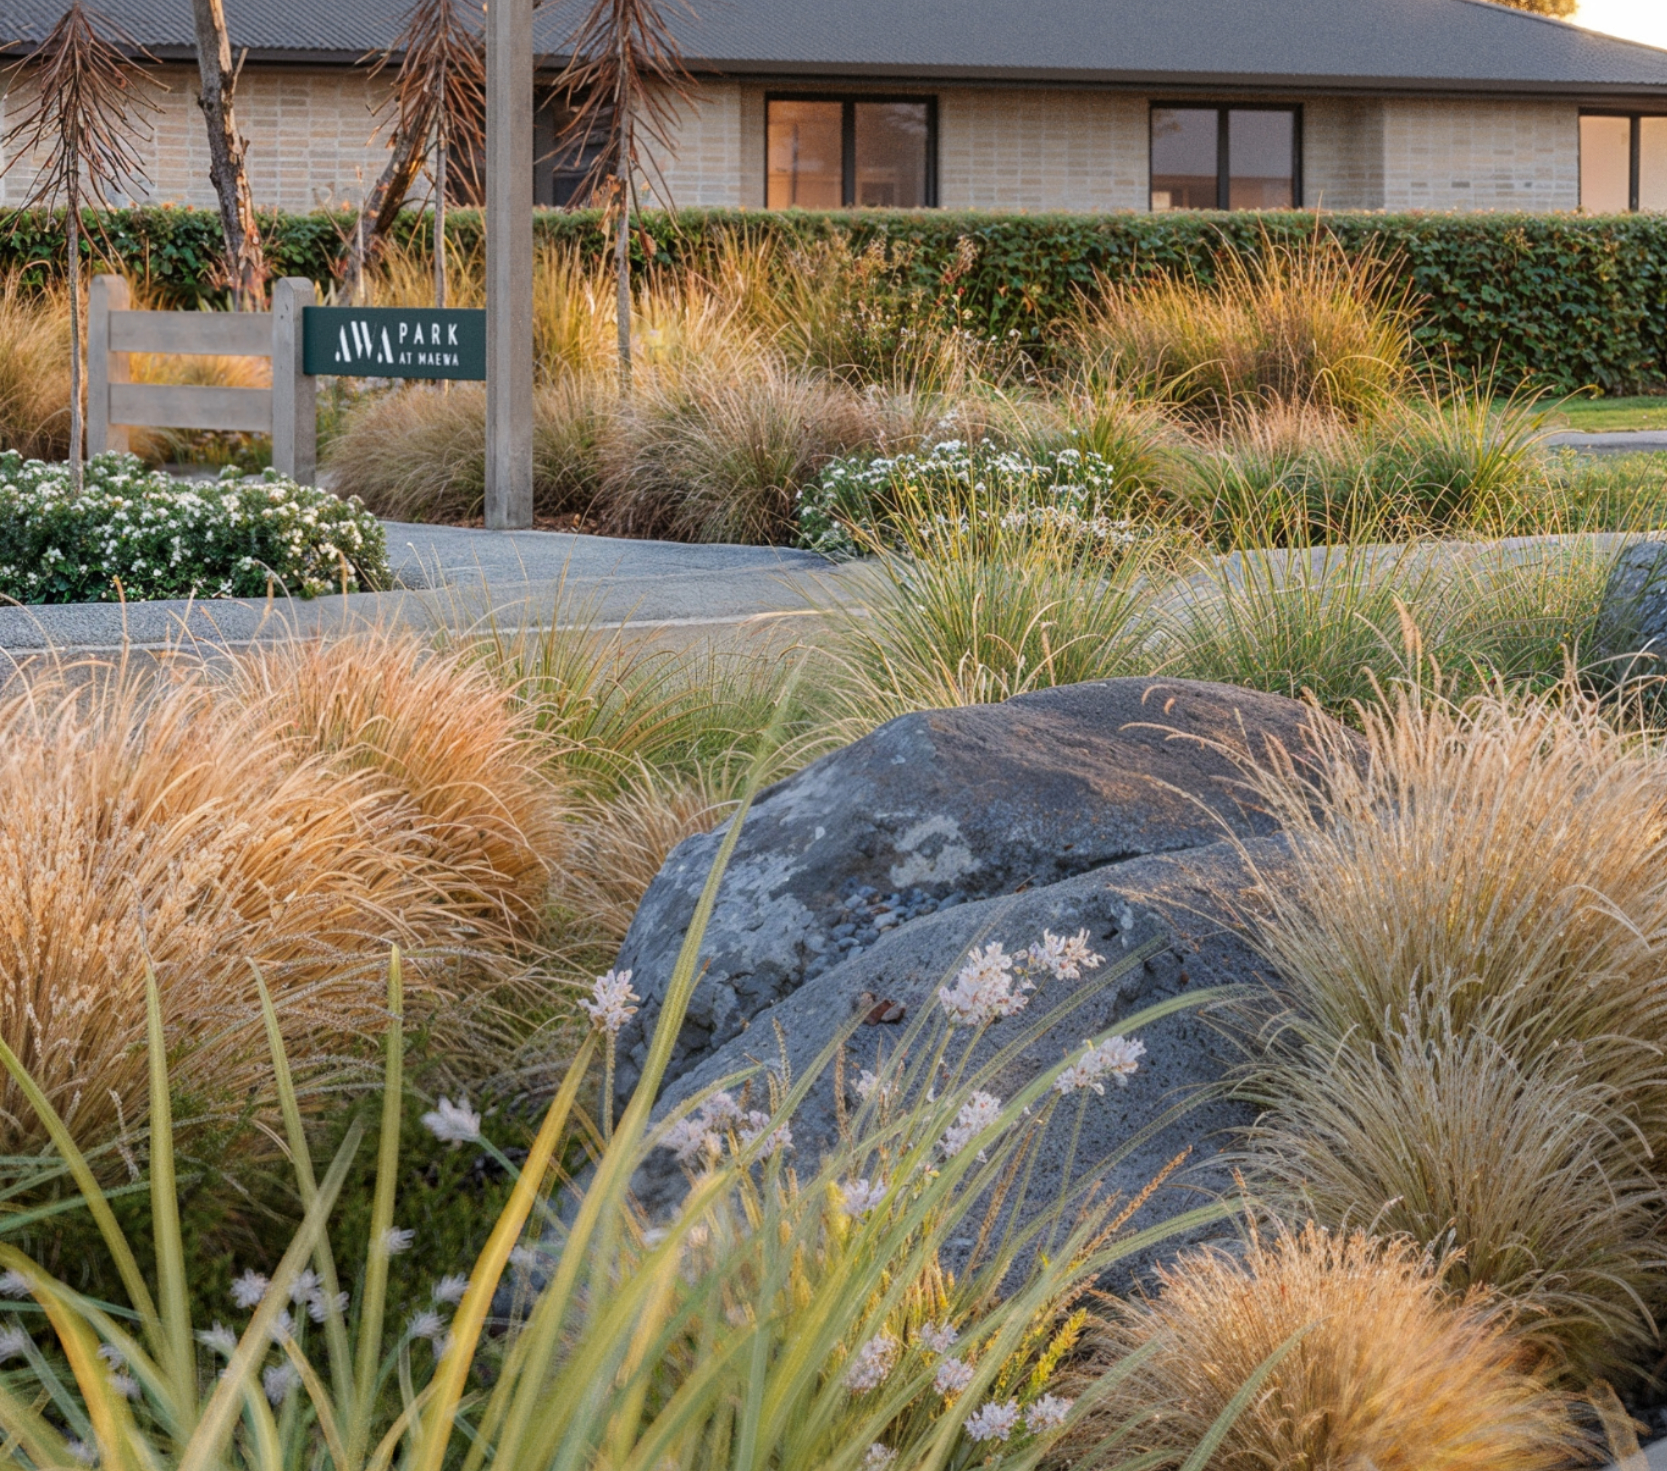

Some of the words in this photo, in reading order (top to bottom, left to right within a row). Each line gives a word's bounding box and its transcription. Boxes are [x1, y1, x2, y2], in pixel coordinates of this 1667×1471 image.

[334, 320, 394, 364] AWA
[399, 322, 459, 346] PARK
[399, 351, 413, 365] AT
[418, 352, 459, 367] MAEWA
